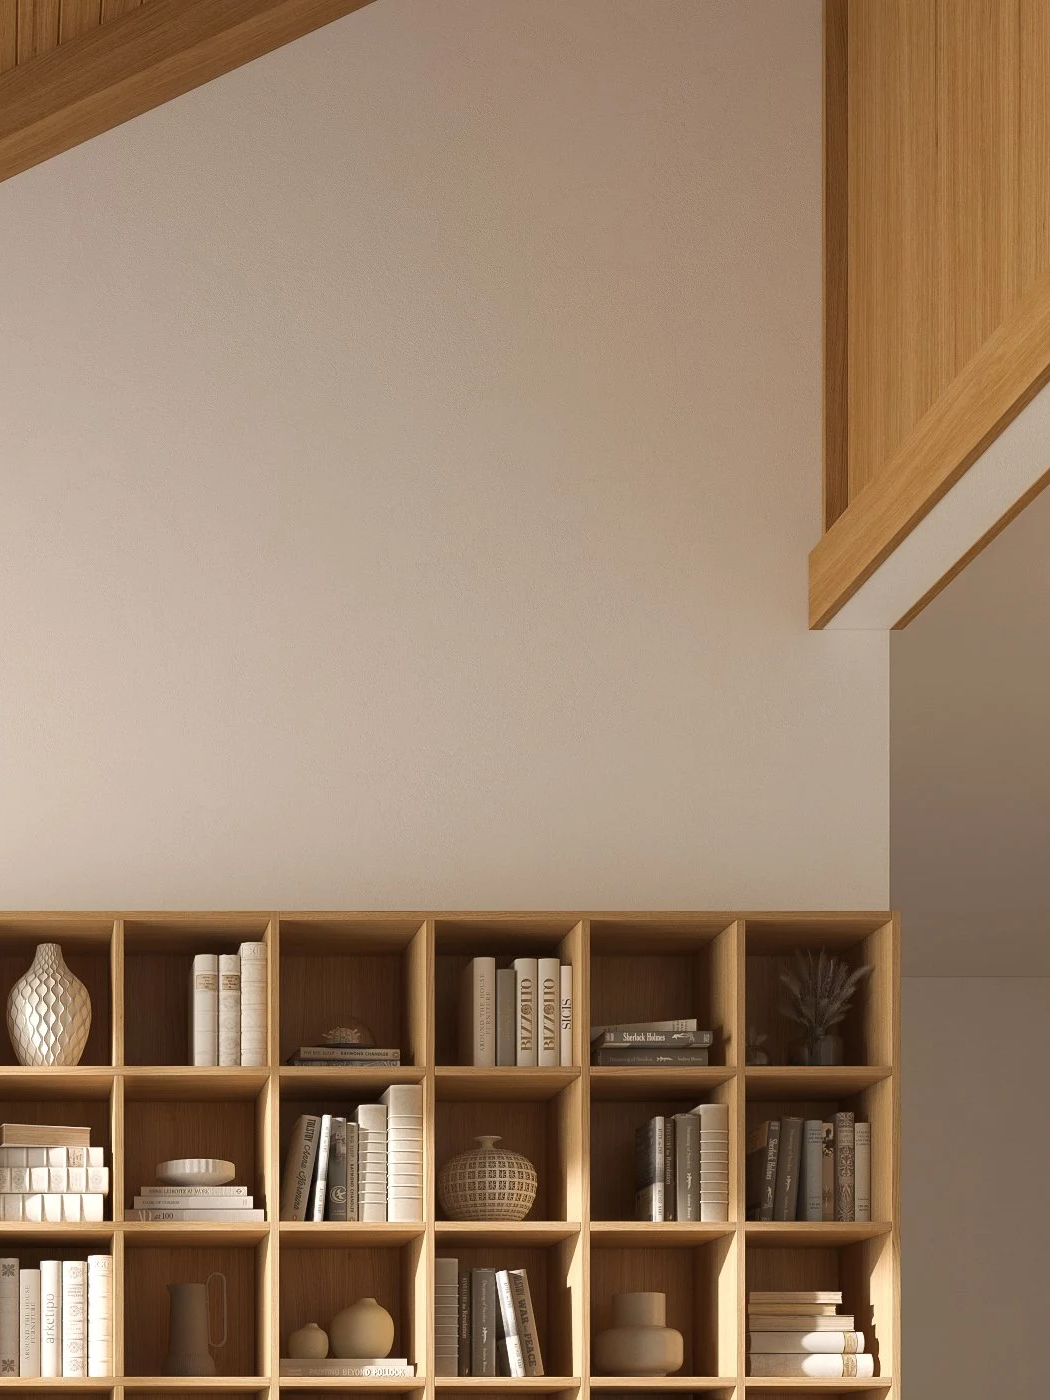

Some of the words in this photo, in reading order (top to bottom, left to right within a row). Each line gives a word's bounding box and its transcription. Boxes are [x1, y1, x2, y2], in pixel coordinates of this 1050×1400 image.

[561, 998, 572, 1030] SICIS
[623, 1032, 645, 1042] Sherlock
[646, 1032, 666, 1042] Holmes
[304, 1119, 317, 1143] TOLSTOY
[300, 1144, 311, 1168] Anna
[768, 1138, 778, 1160] Sherlock
[766, 1160, 777, 1180] Holmes
[294, 1170, 307, 1211] Karenina
[162, 1212, 174, 1220] 100
[42, 1293, 58, 1344] arketipo
[518, 1298, 530, 1325] WAR
[524, 1332, 537, 1367] PEACE
[373, 1368, 405, 1377] POLLOCK
